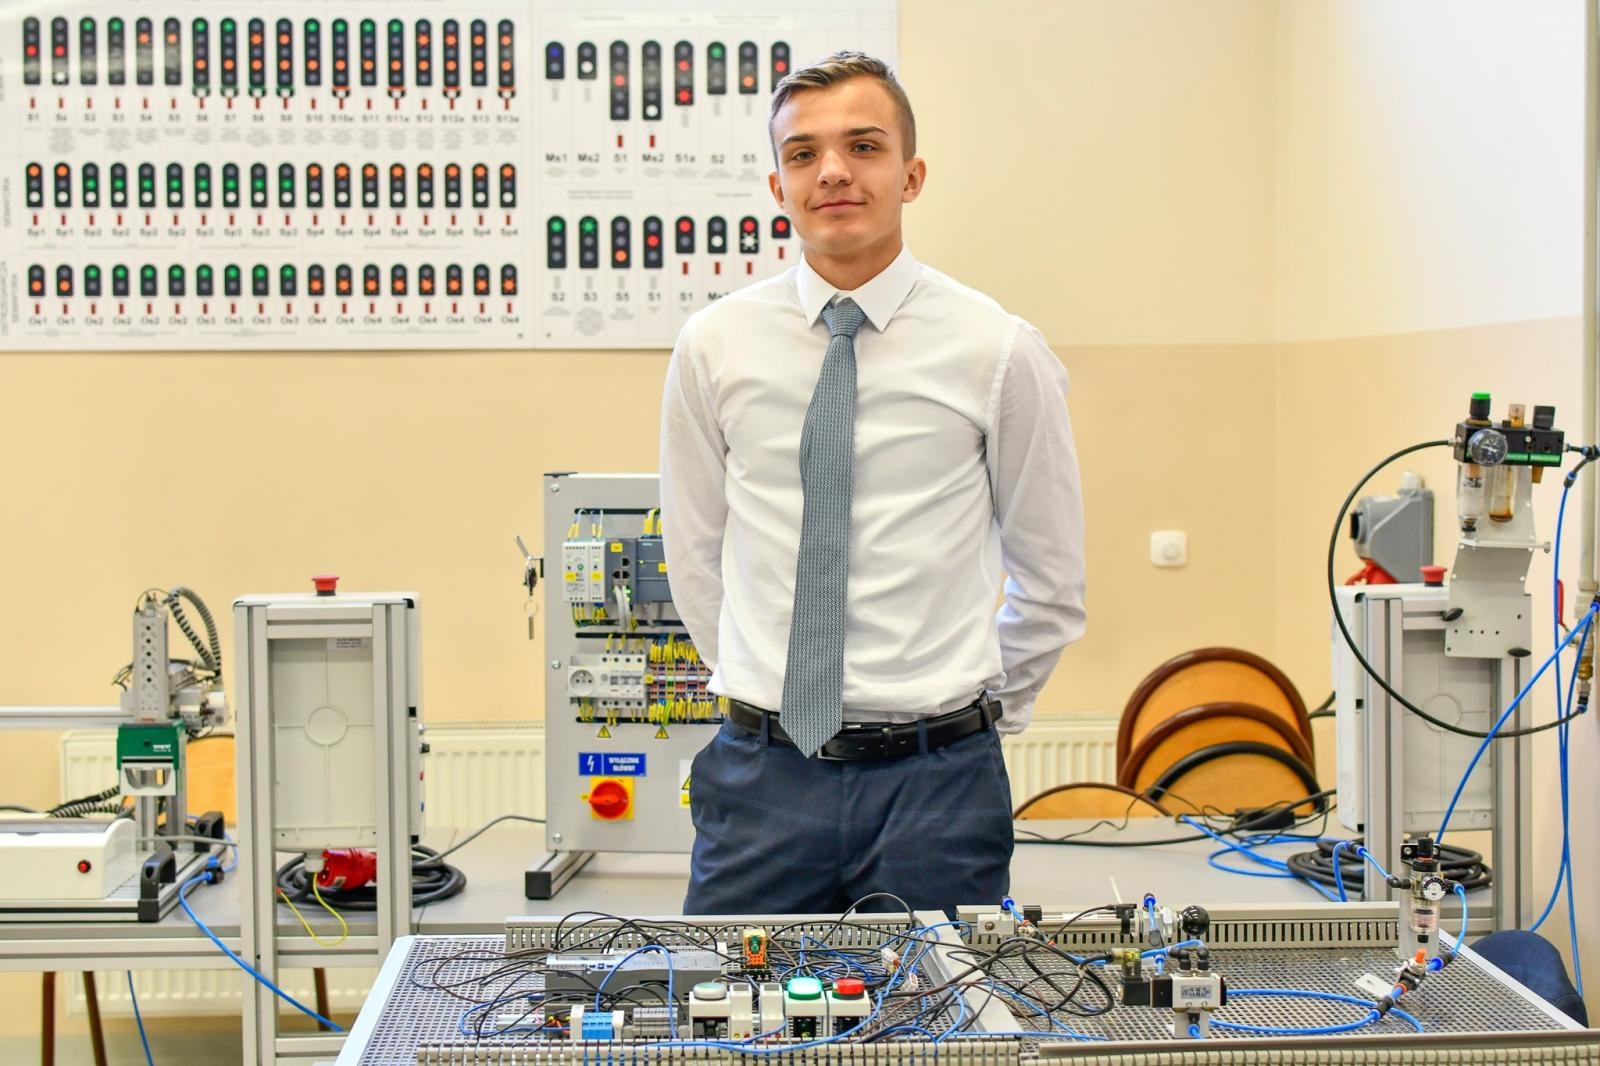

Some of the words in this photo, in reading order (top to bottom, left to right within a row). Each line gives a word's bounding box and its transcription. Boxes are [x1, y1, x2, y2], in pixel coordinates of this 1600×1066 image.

[84, 113, 96, 123] S2
[112, 113, 124, 122] S3
[140, 113, 152, 123] S4
[545, 153, 566, 162] Ms1
[577, 153, 599, 163] Ms2
[614, 153, 626, 162] S1
[642, 153, 664, 163] Ms2
[676, 153, 696, 163] S1a
[712, 154, 724, 164] S2
[743, 154, 756, 163] S5
[551, 292, 565, 302] S2
[583, 292, 597, 302] S3
[616, 292, 630, 302] S5
[648, 291, 661, 302] S1
[680, 292, 693, 302] S1
